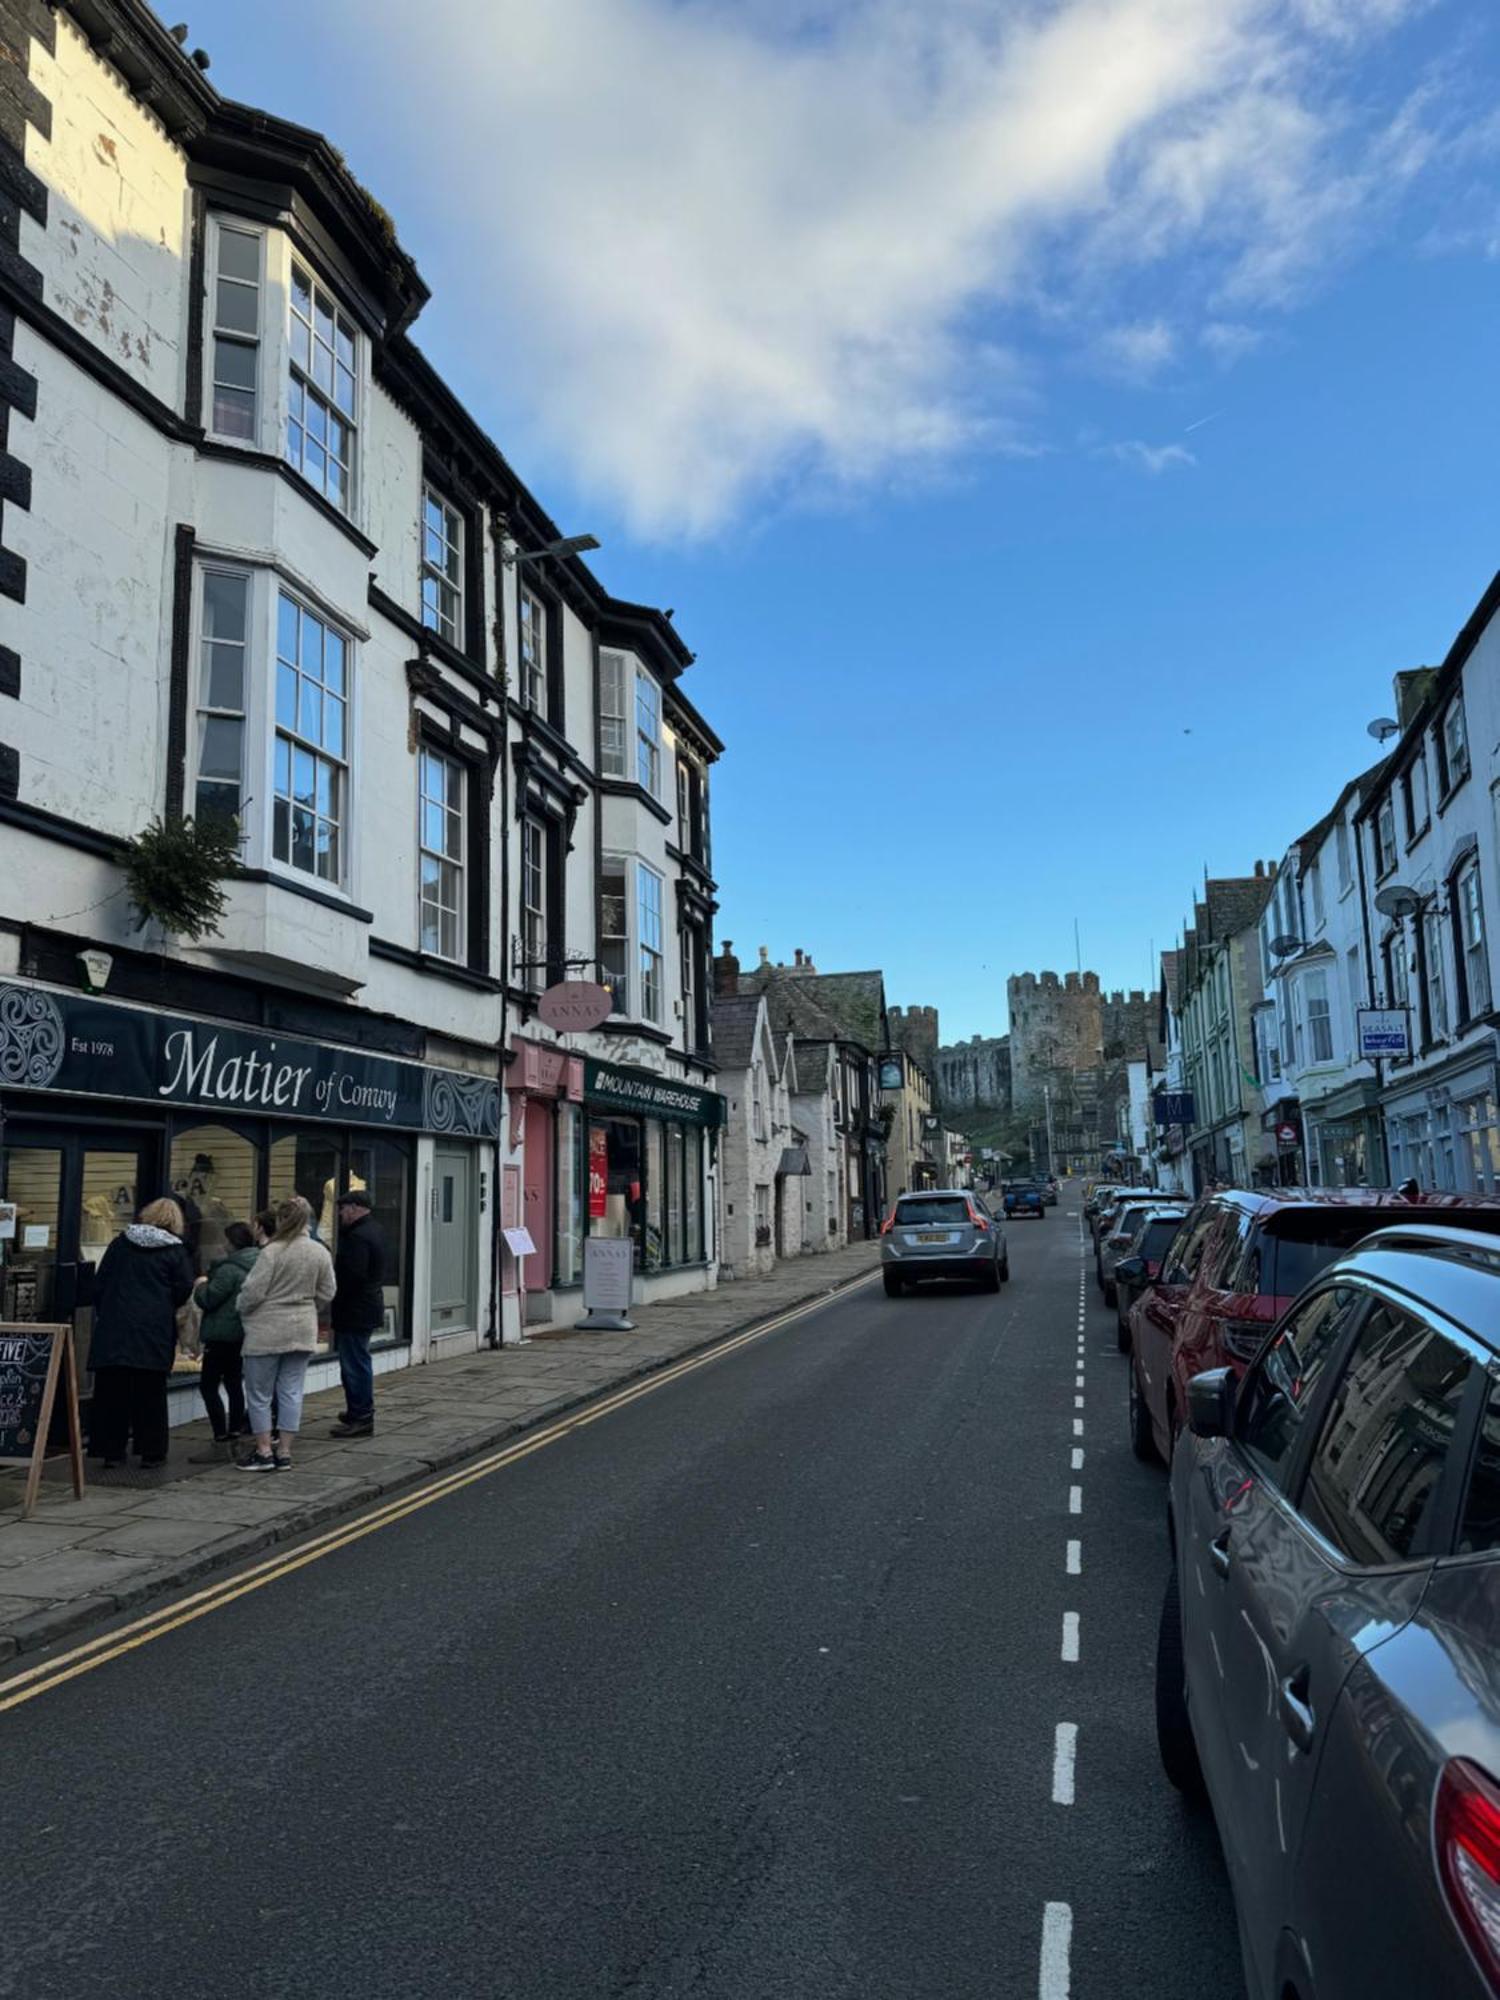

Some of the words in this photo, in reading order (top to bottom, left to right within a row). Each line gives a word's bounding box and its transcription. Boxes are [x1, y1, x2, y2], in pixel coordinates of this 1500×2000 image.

[548, 1005, 601, 1017] ANNAS
[71, 1037, 88, 1053] Est
[91, 1041, 114, 1057] 1978
[159, 1030, 312, 1107] Matier
[316, 1071, 337, 1112] of
[339, 1075, 397, 1121] Conwy
[603, 1074, 653, 1100] MOUNTAIN
[653, 1087, 702, 1111] WAREHOUSE
